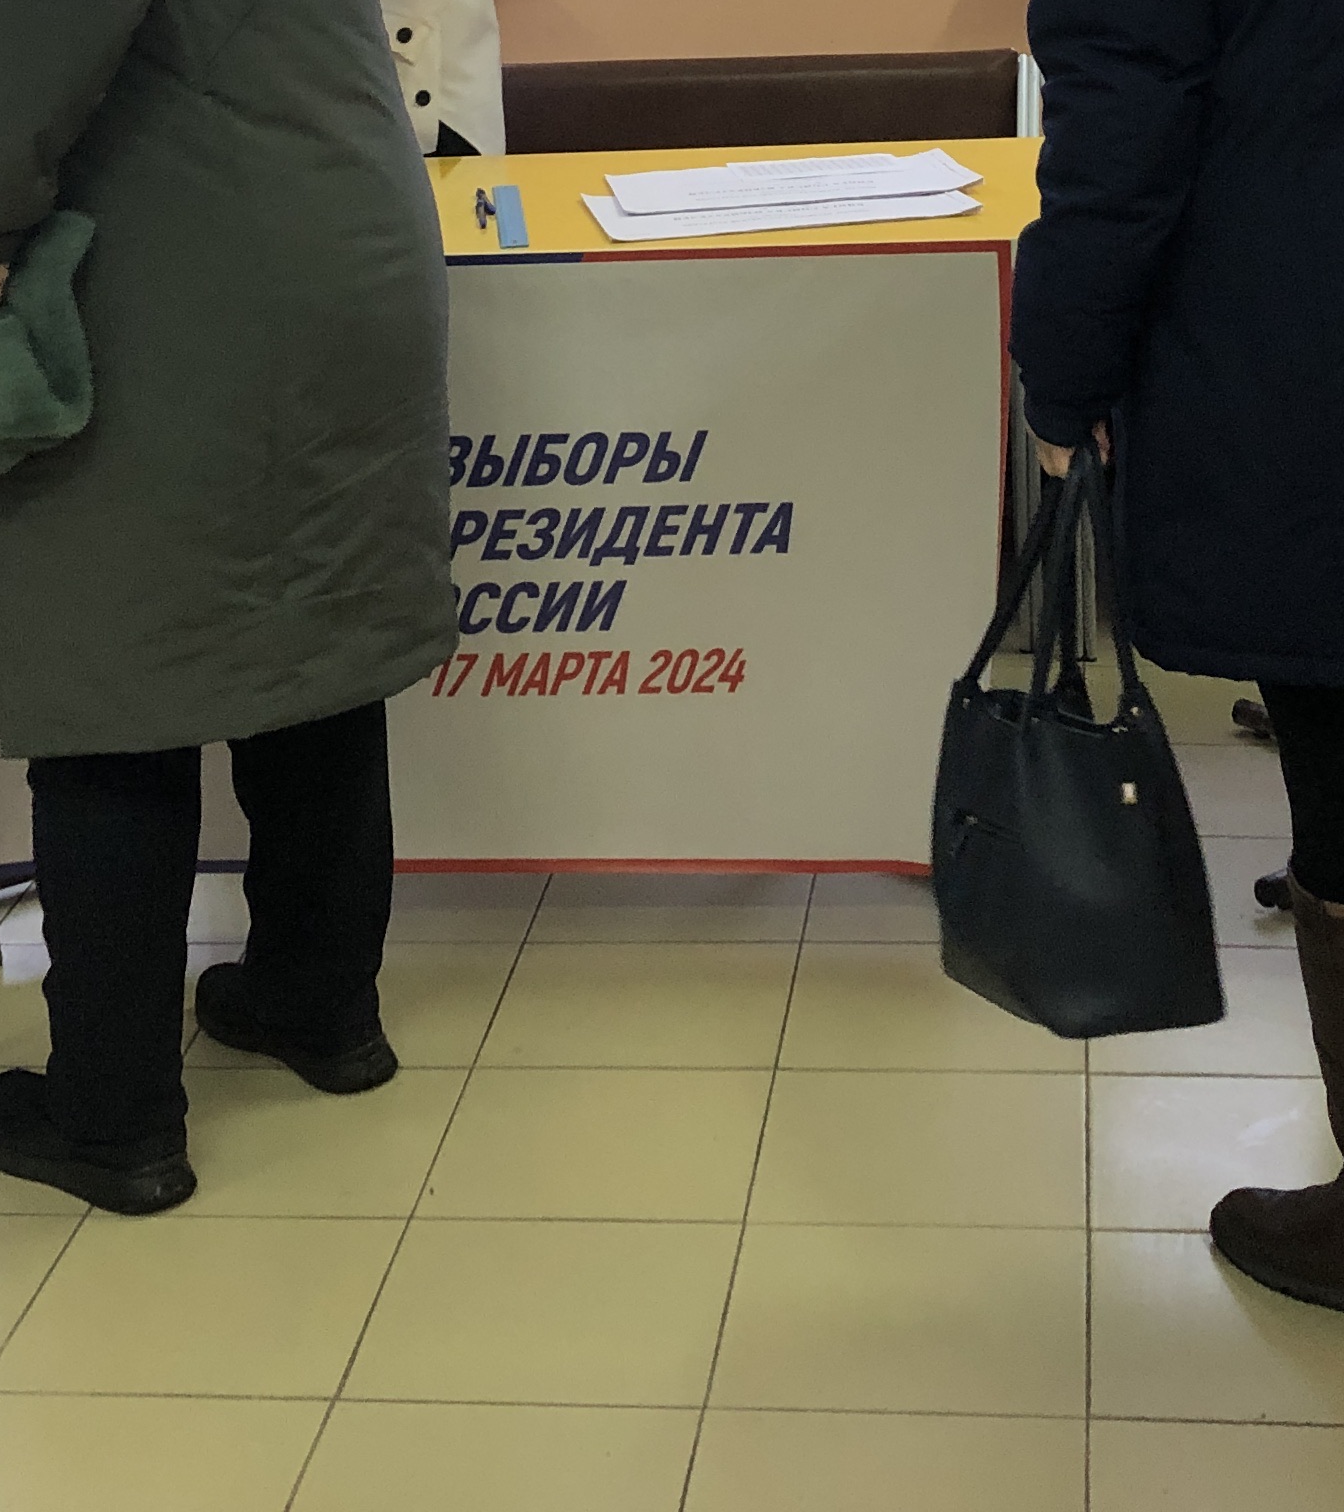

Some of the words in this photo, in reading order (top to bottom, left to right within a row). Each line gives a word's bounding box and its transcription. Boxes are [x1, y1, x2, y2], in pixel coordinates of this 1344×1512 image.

[449, 429, 708, 489] ВЫБОРЫ
[451, 501, 794, 567] РЕЗИДЕНТА
[454, 579, 627, 635] ССИИ
[481, 648, 632, 698] МАРТА
[638, 646, 748, 696] 2024
